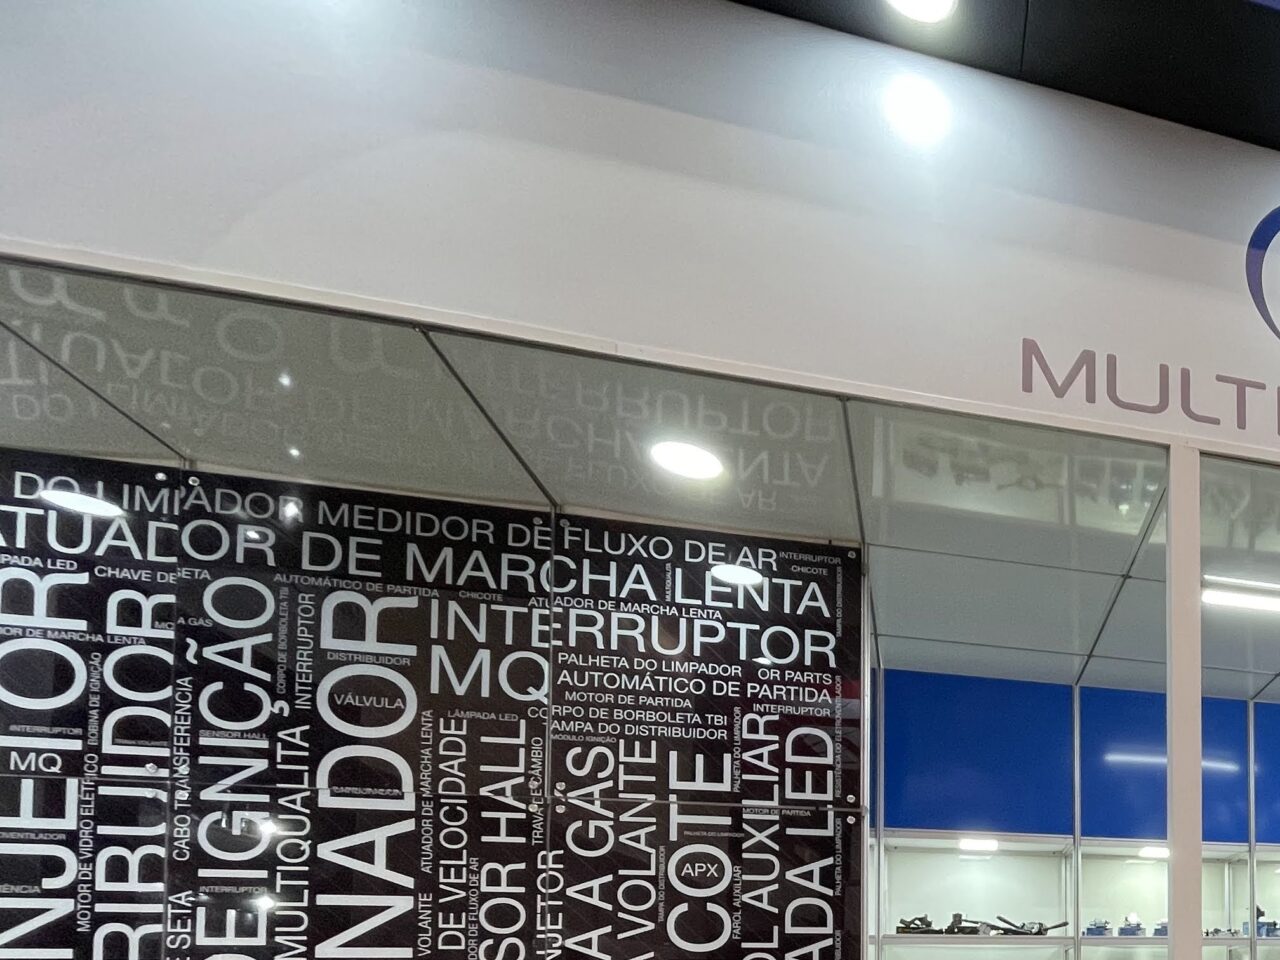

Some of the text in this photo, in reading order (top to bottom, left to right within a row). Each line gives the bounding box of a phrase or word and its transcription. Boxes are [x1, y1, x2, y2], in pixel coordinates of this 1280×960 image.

[317, 500, 495, 545] MEDIDOR
[507, 522, 552, 550] DE
[563, 526, 674, 560] FLUXO
[684, 540, 727, 565] DE
[735, 546, 778, 571] AR
[779, 551, 841, 565] INTERRUPTOR
[791, 564, 828, 576] CHICOTE
[94, 565, 152, 582] CHAVE
[157, 571, 177, 584] DE
[273, 573, 440, 598] AUTOMÁTICO DE PARTIDA
[302, 531, 383, 578] DE
[405, 543, 657, 602] MARCHA
[674, 567, 831, 618] LENTA
[458, 590, 503, 603] CHICOTE
[527, 597, 723, 621] ATUADOR DE MARCHA LENTA
[47, 630, 104, 643] MARCHA
[107, 635, 146, 645] LENTA
[430, 598, 836, 668] INTERRUPTOR
[294, 592, 314, 710] INTERRUPTOR
[327, 651, 411, 667] DISTRIBUIDOR
[558, 652, 742, 678] PALHETA DO LIMPADOR
[430, 645, 549, 705] MQ
[557, 668, 832, 704] AUTOMÁTICO DE PARTIDA
[757, 667, 833, 686] OR PARTS
[87, 652, 102, 745] BOBINA DE IGNIÇÃO
[334, 691, 405, 710] VÁLVULA
[564, 691, 692, 709] MOTOR DE PARTIDA
[753, 703, 831, 717] INTERRUPTOR
[498, 711, 519, 722] LED
[588, 707, 609, 719] DE
[613, 708, 702, 725] BORBOLETA
[705, 713, 728, 726] TBI
[598, 722, 621, 736] DO
[624, 723, 728, 740] DISTRIBUIDOR
[9, 751, 62, 773] MQ
[420, 709, 434, 874] ATUADOR DE MARCHA LENTA
[479, 718, 527, 843] HALL
[785, 727, 834, 837] LED
[438, 718, 469, 903] VELOCIDADE
[555, 745, 615, 858] GÁS
[741, 712, 780, 914] AUXILIAR
[78, 819, 94, 859] VIDRO
[531, 806, 544, 846] TRAVA
[616, 738, 657, 940] VOLANTE
[77, 863, 93, 880] DE
[469, 857, 479, 871] AR
[680, 863, 719, 878] APX
[469, 873, 479, 887] DE
[565, 874, 614, 911] A
[77, 884, 92, 932] MOTOR
[468, 889, 479, 920] FLUXO
[732, 865, 741, 940] FAROL AUXILIAR
[166, 890, 193, 949] SETA
[417, 892, 433, 957] VOLANTE
[438, 911, 467, 950] DE
[468, 923, 478, 937] DE
